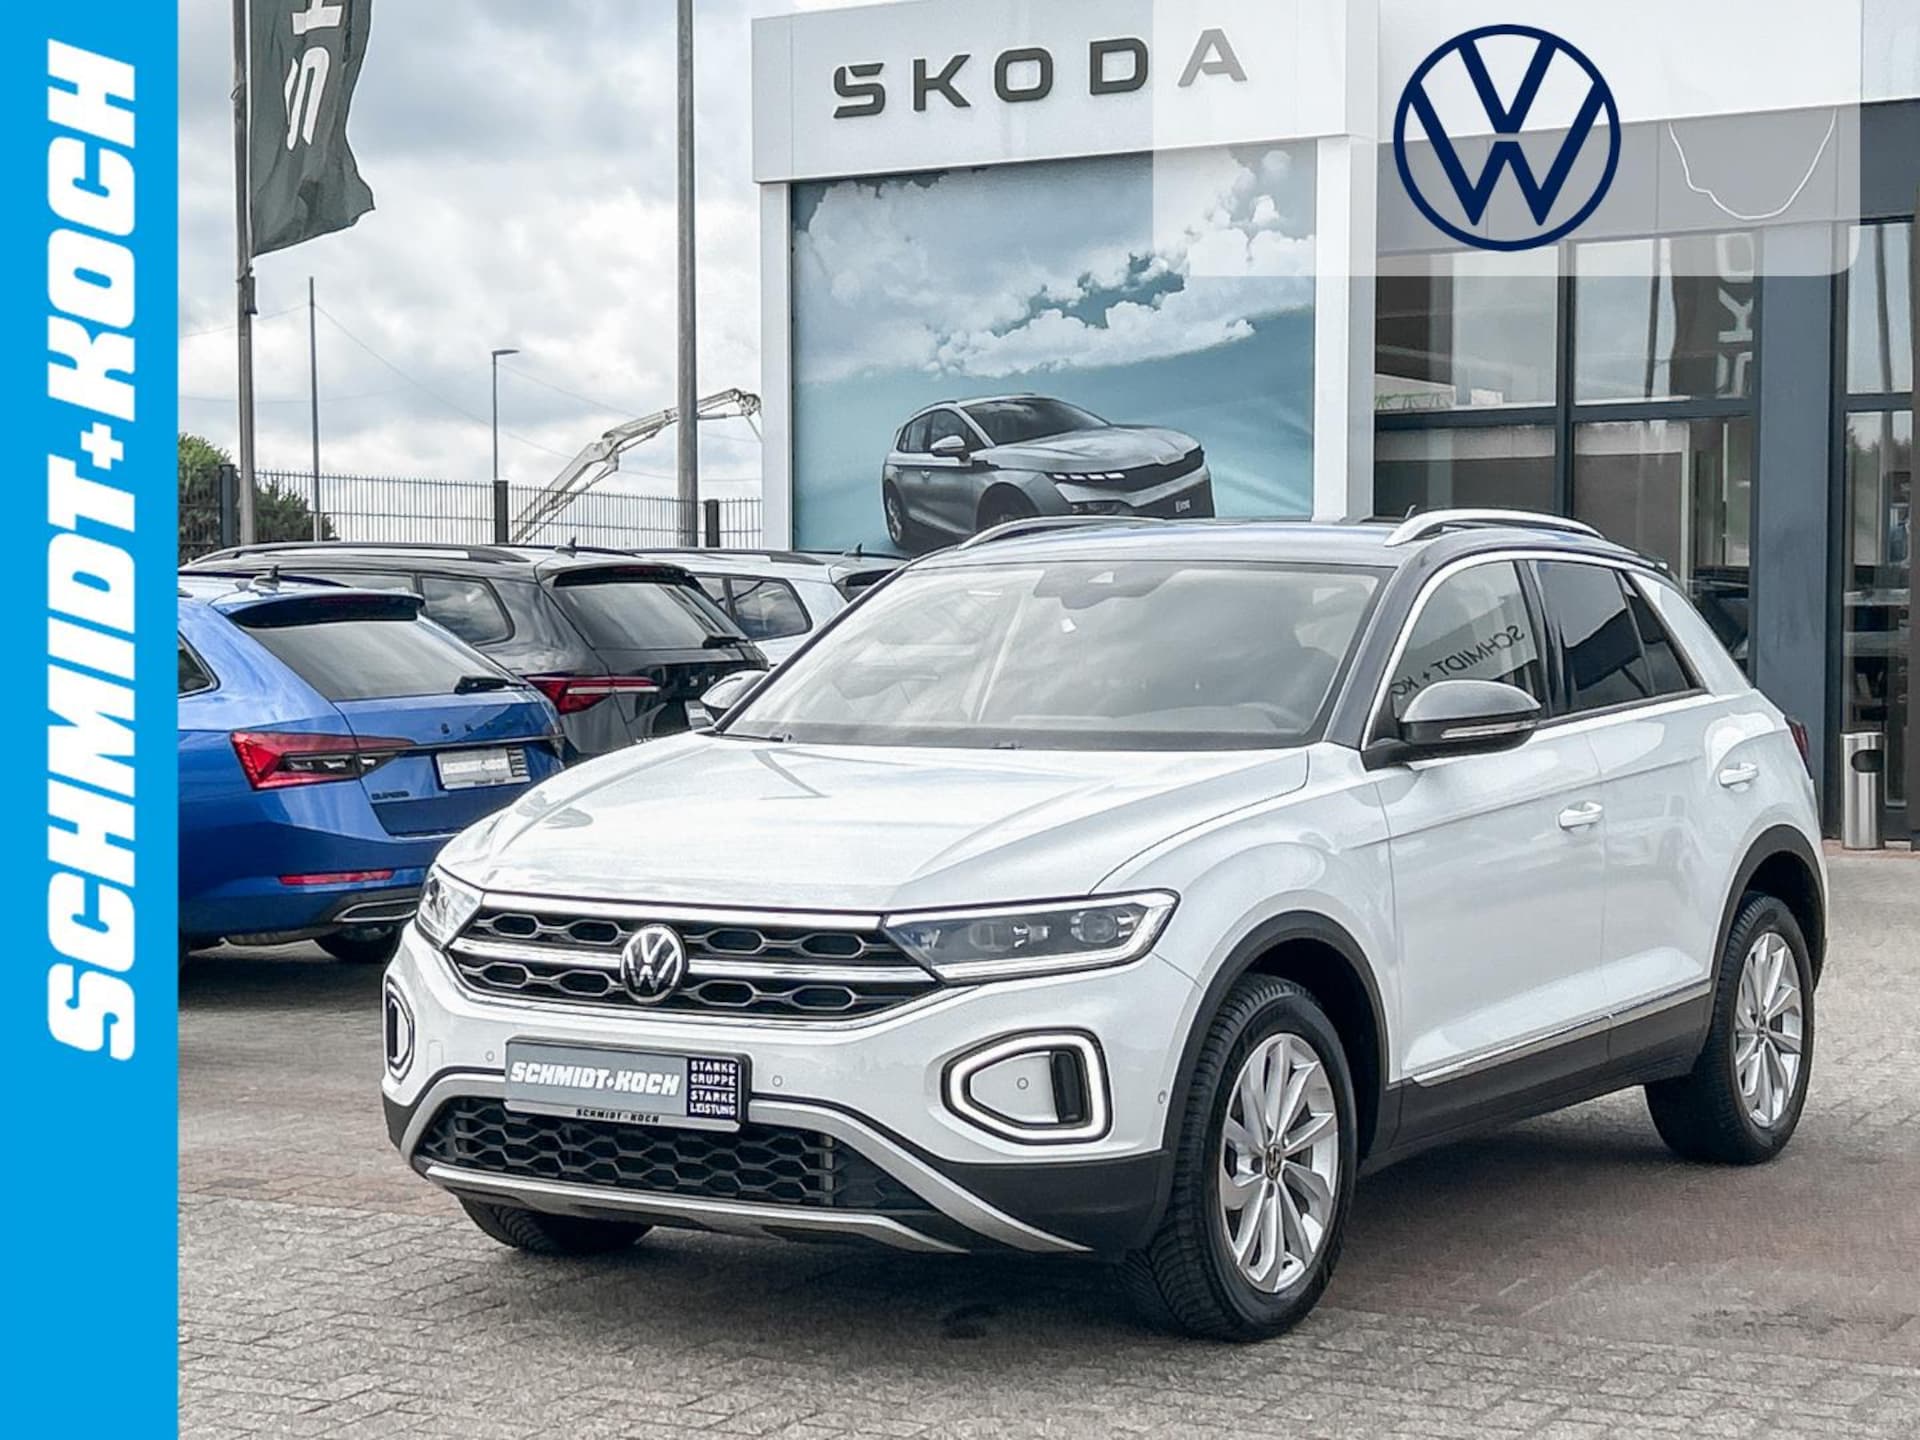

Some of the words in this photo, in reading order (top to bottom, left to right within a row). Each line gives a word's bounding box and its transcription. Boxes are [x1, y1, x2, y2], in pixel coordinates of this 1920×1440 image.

[690, 1060, 736, 1074] STARKE
[690, 1073, 736, 1086] GRUPPE
[690, 1090, 736, 1104] STARKE
